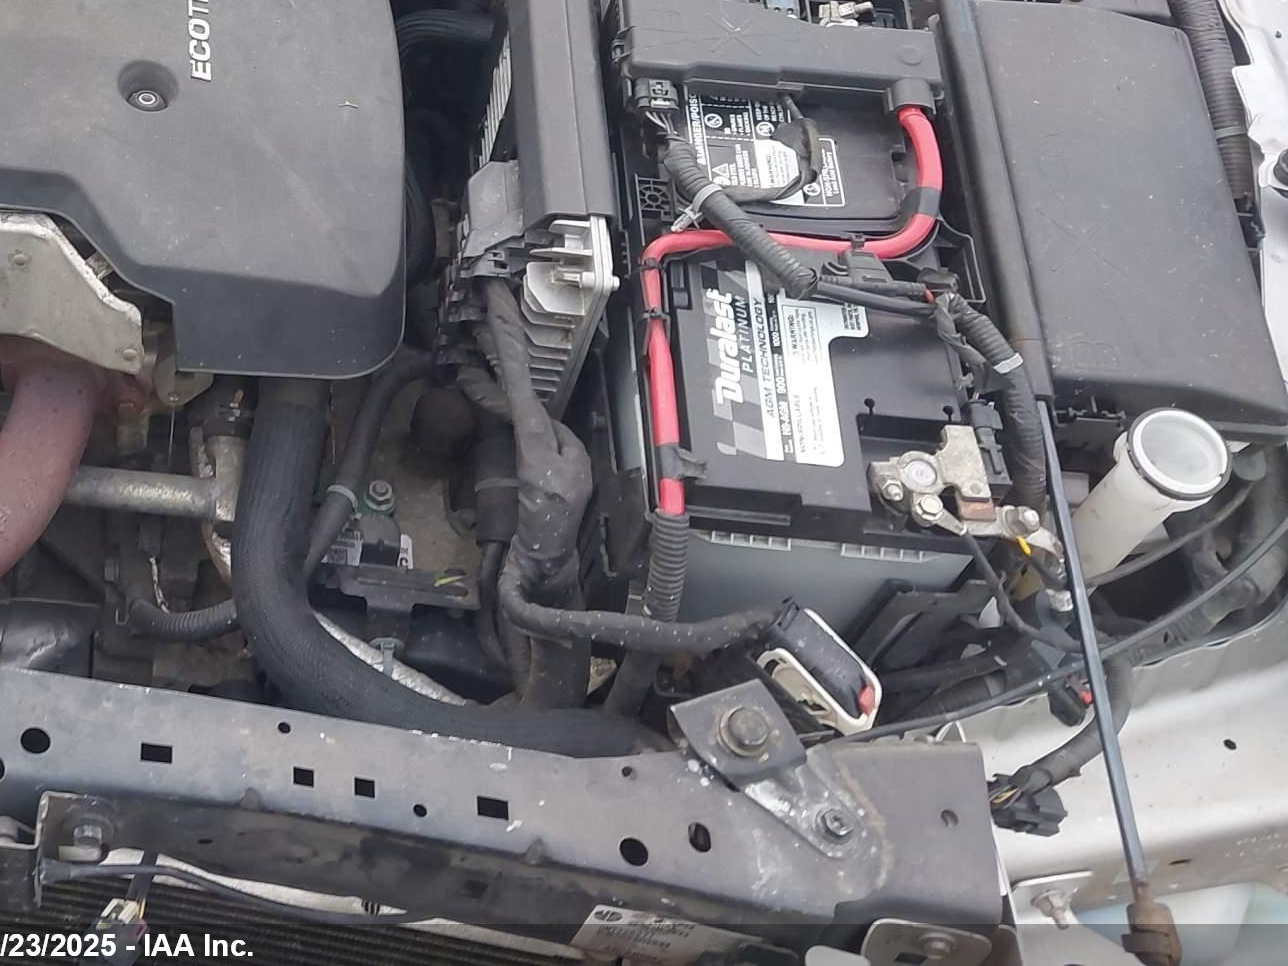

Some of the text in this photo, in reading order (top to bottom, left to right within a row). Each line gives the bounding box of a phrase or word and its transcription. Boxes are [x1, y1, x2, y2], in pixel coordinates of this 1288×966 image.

[706, 288, 744, 405] Duralast
[734, 296, 754, 373] PLATINUM
[752, 298, 777, 418] AGM TECHNOLOGY
